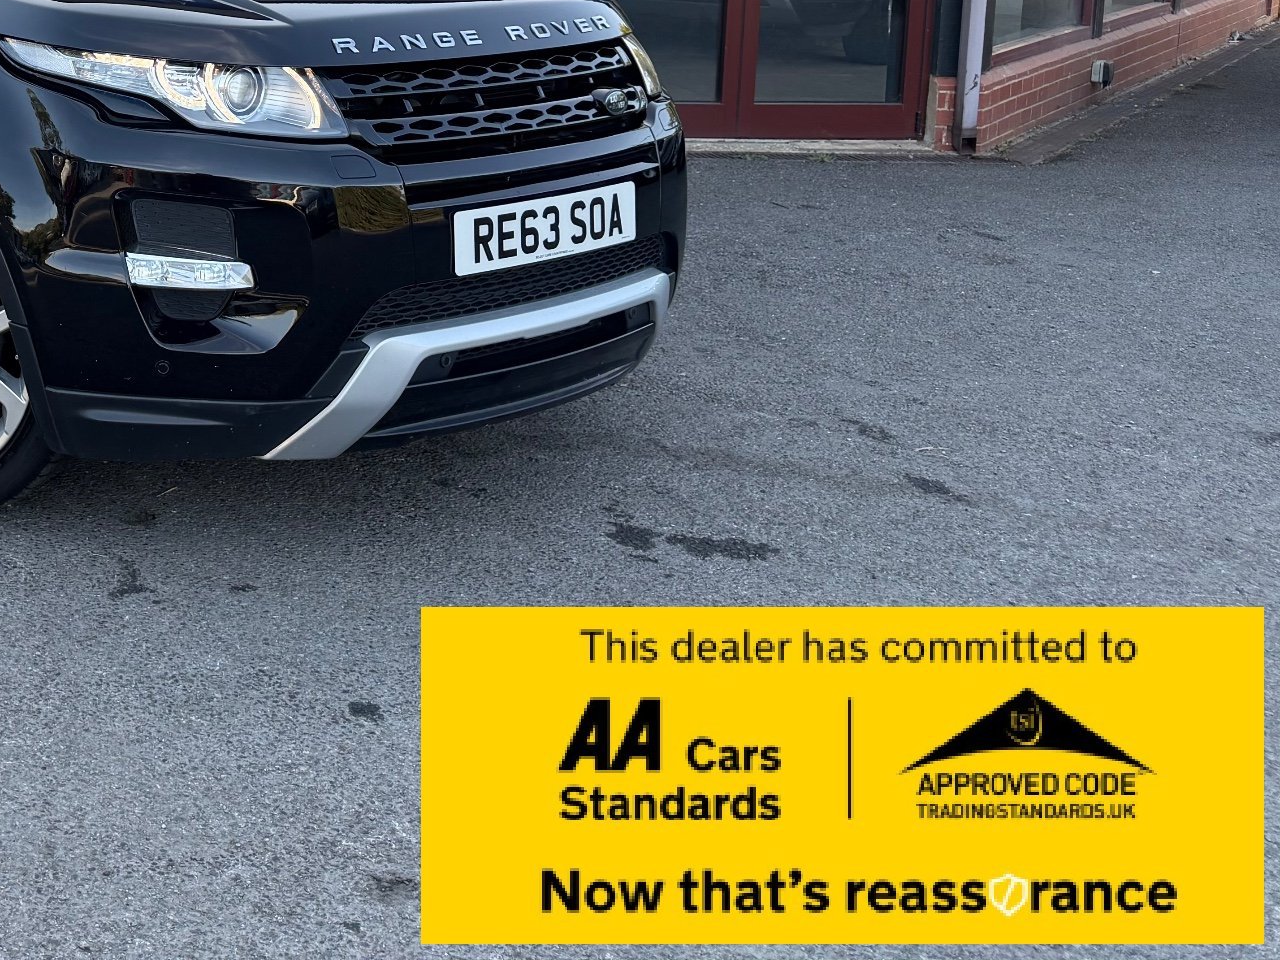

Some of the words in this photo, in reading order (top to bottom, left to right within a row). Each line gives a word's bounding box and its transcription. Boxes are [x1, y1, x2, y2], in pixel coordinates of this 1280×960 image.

[331, 28, 483, 54] RANGE
[504, 15, 611, 41] ROVER
[473, 204, 560, 264] RE63
[570, 193, 623, 245] SOA
